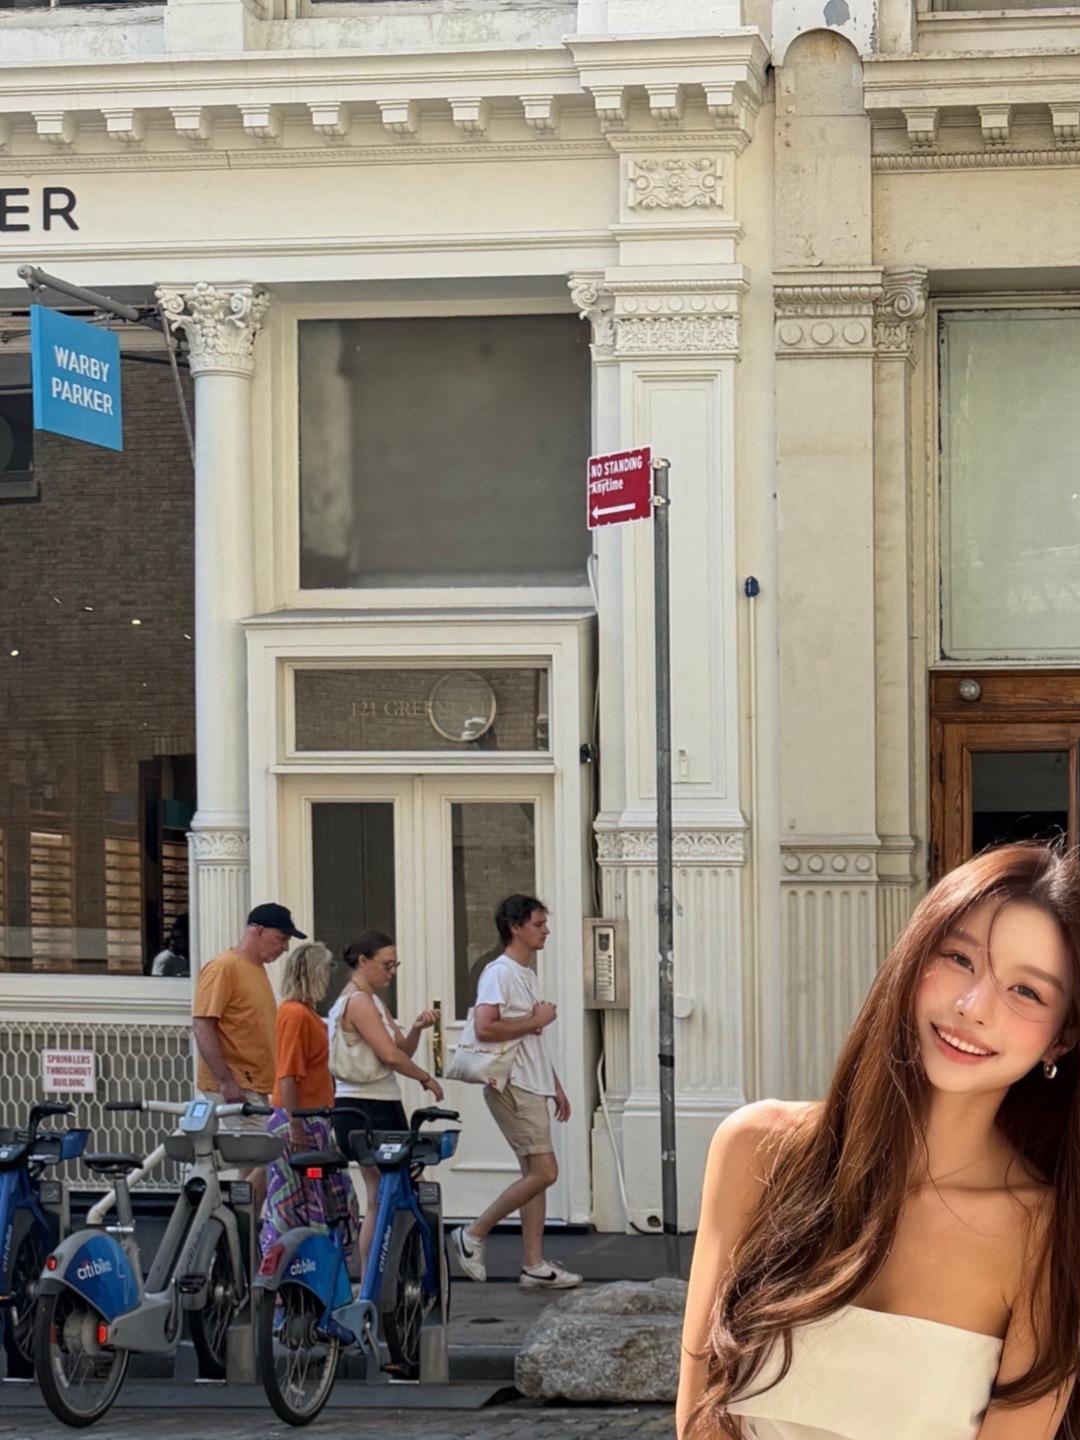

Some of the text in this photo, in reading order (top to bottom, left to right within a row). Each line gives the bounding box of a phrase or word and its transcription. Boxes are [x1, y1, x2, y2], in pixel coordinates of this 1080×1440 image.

[0, 187, 79, 232] ER
[54, 345, 111, 382] WARBY
[51, 377, 113, 415] PARKER
[591, 455, 643, 478] NO STANDING
